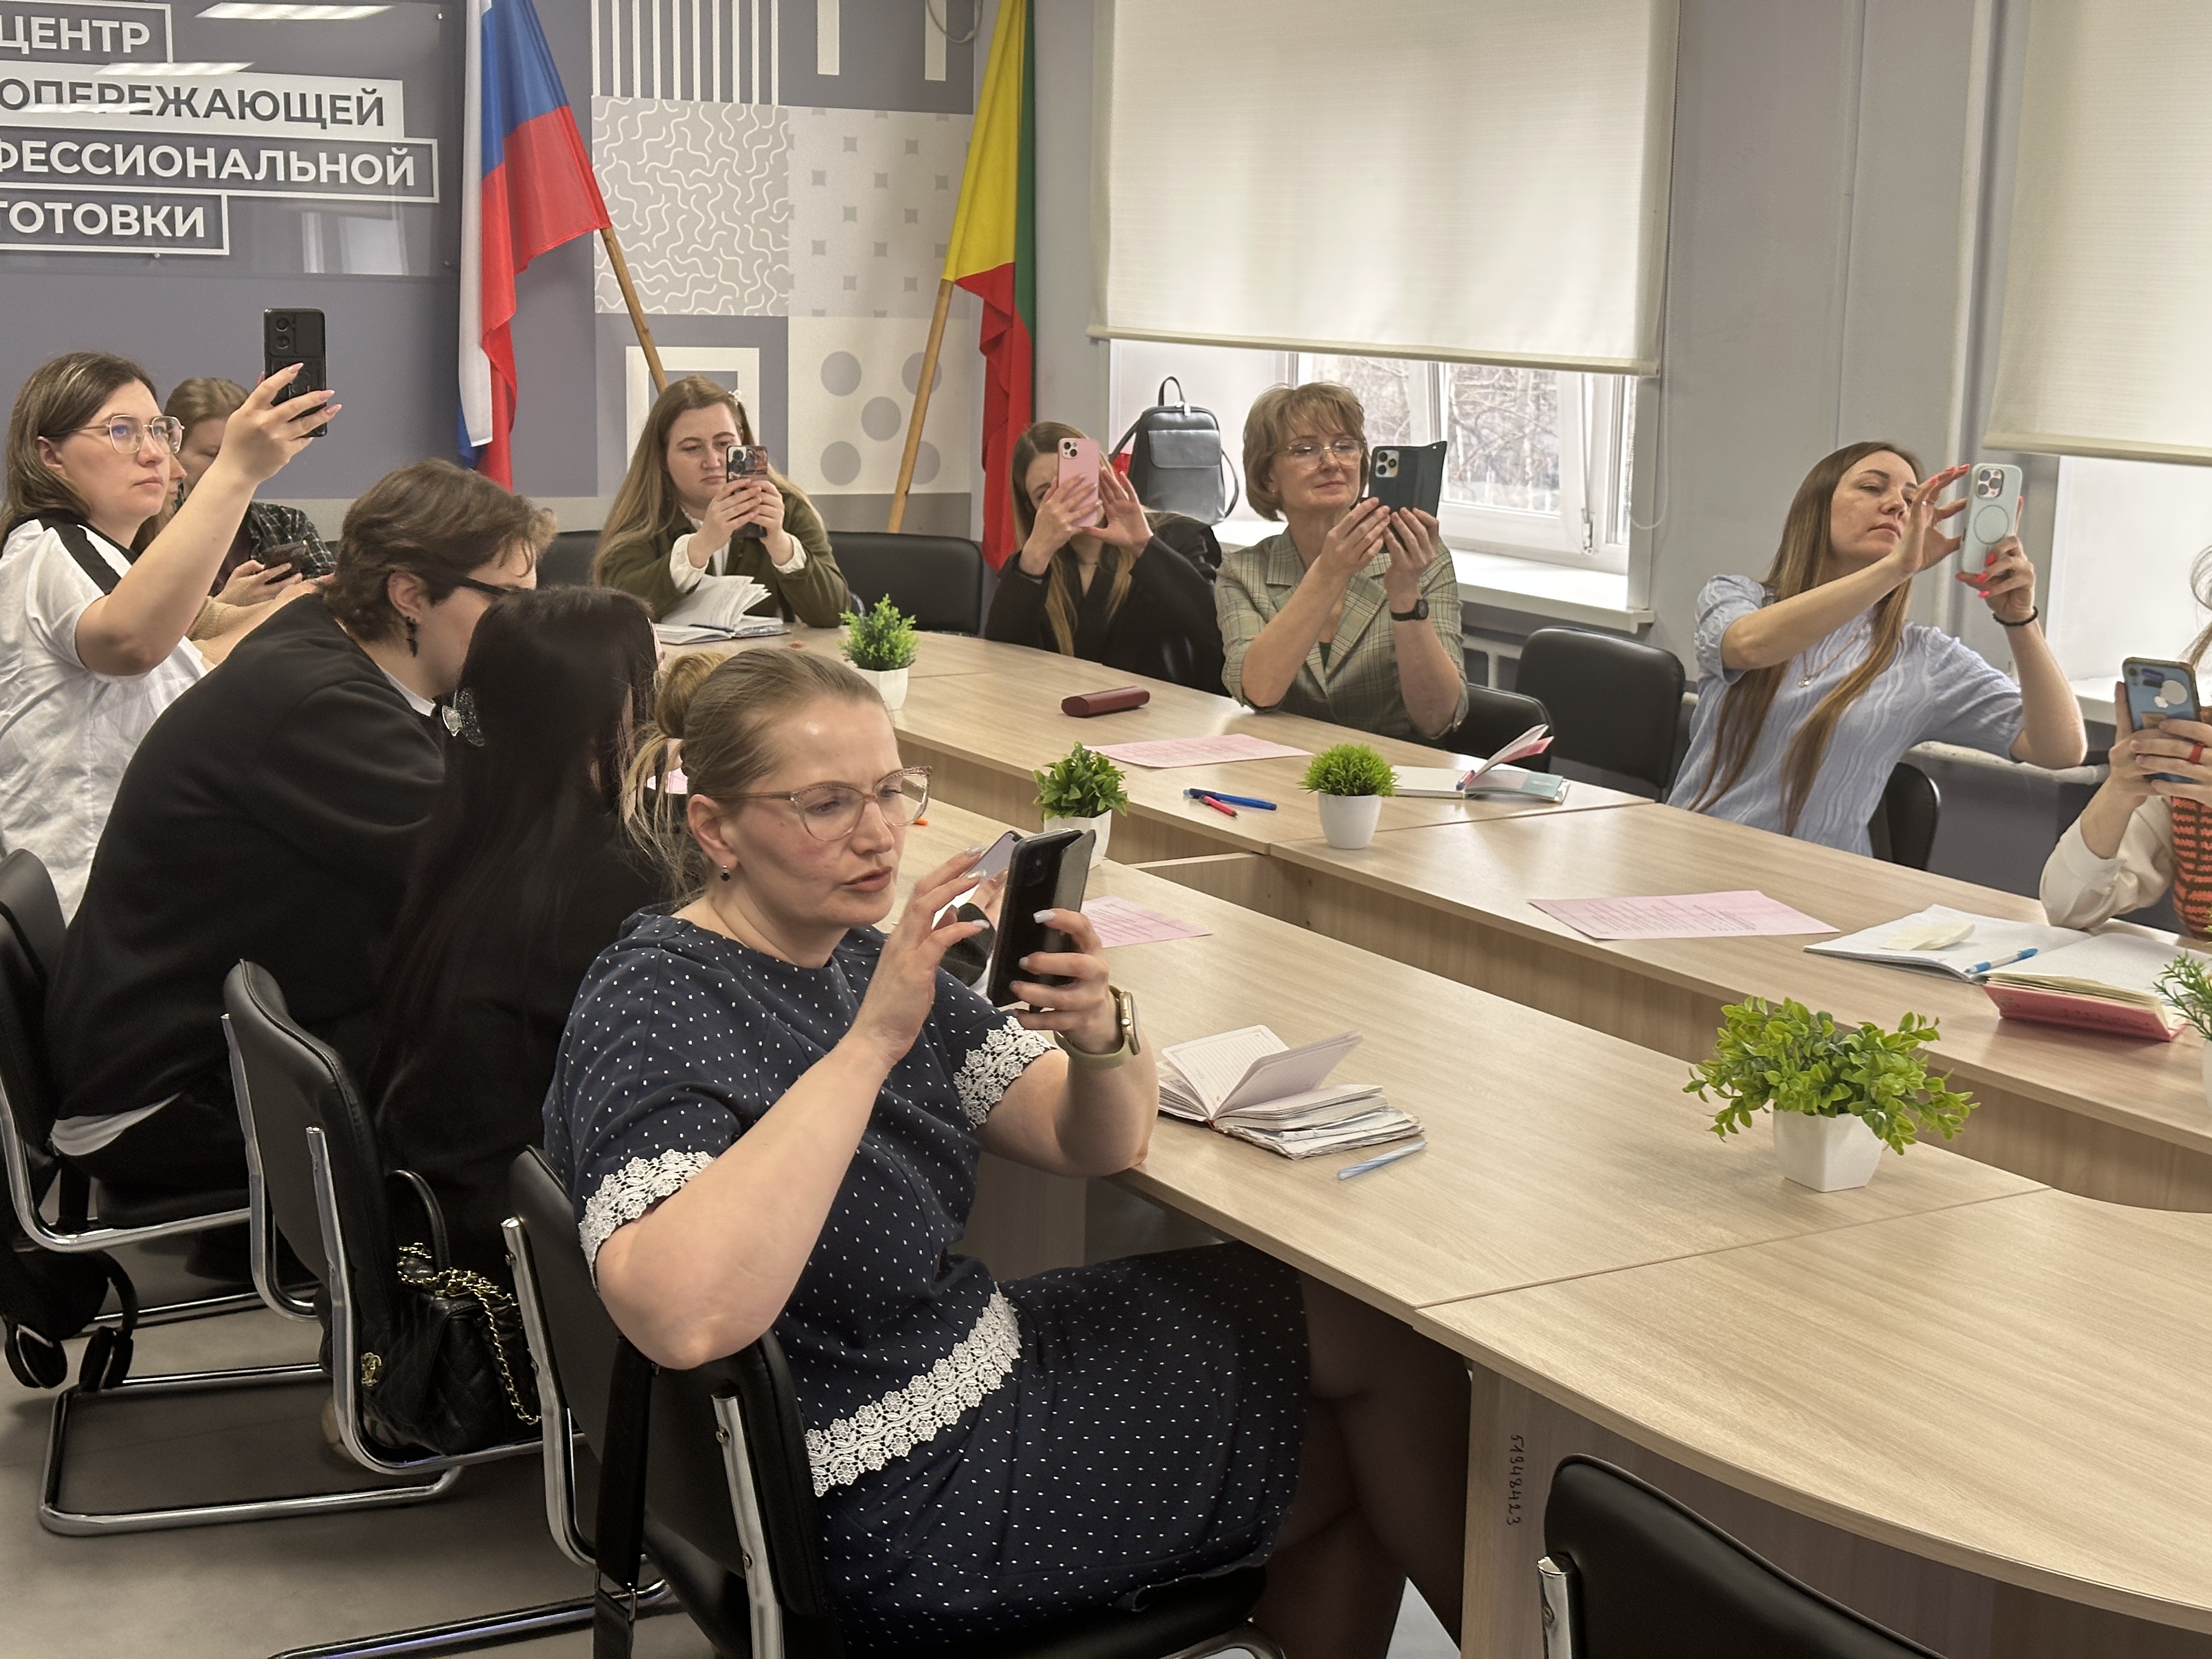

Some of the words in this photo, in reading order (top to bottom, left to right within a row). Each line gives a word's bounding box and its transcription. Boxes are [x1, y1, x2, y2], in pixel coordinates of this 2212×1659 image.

[0, 15, 150, 54] ЦЕНТР
[0, 78, 383, 129] ОПЕРЕЖАЮЩЕЙ
[0, 200, 205, 238] ОТОВКИ
